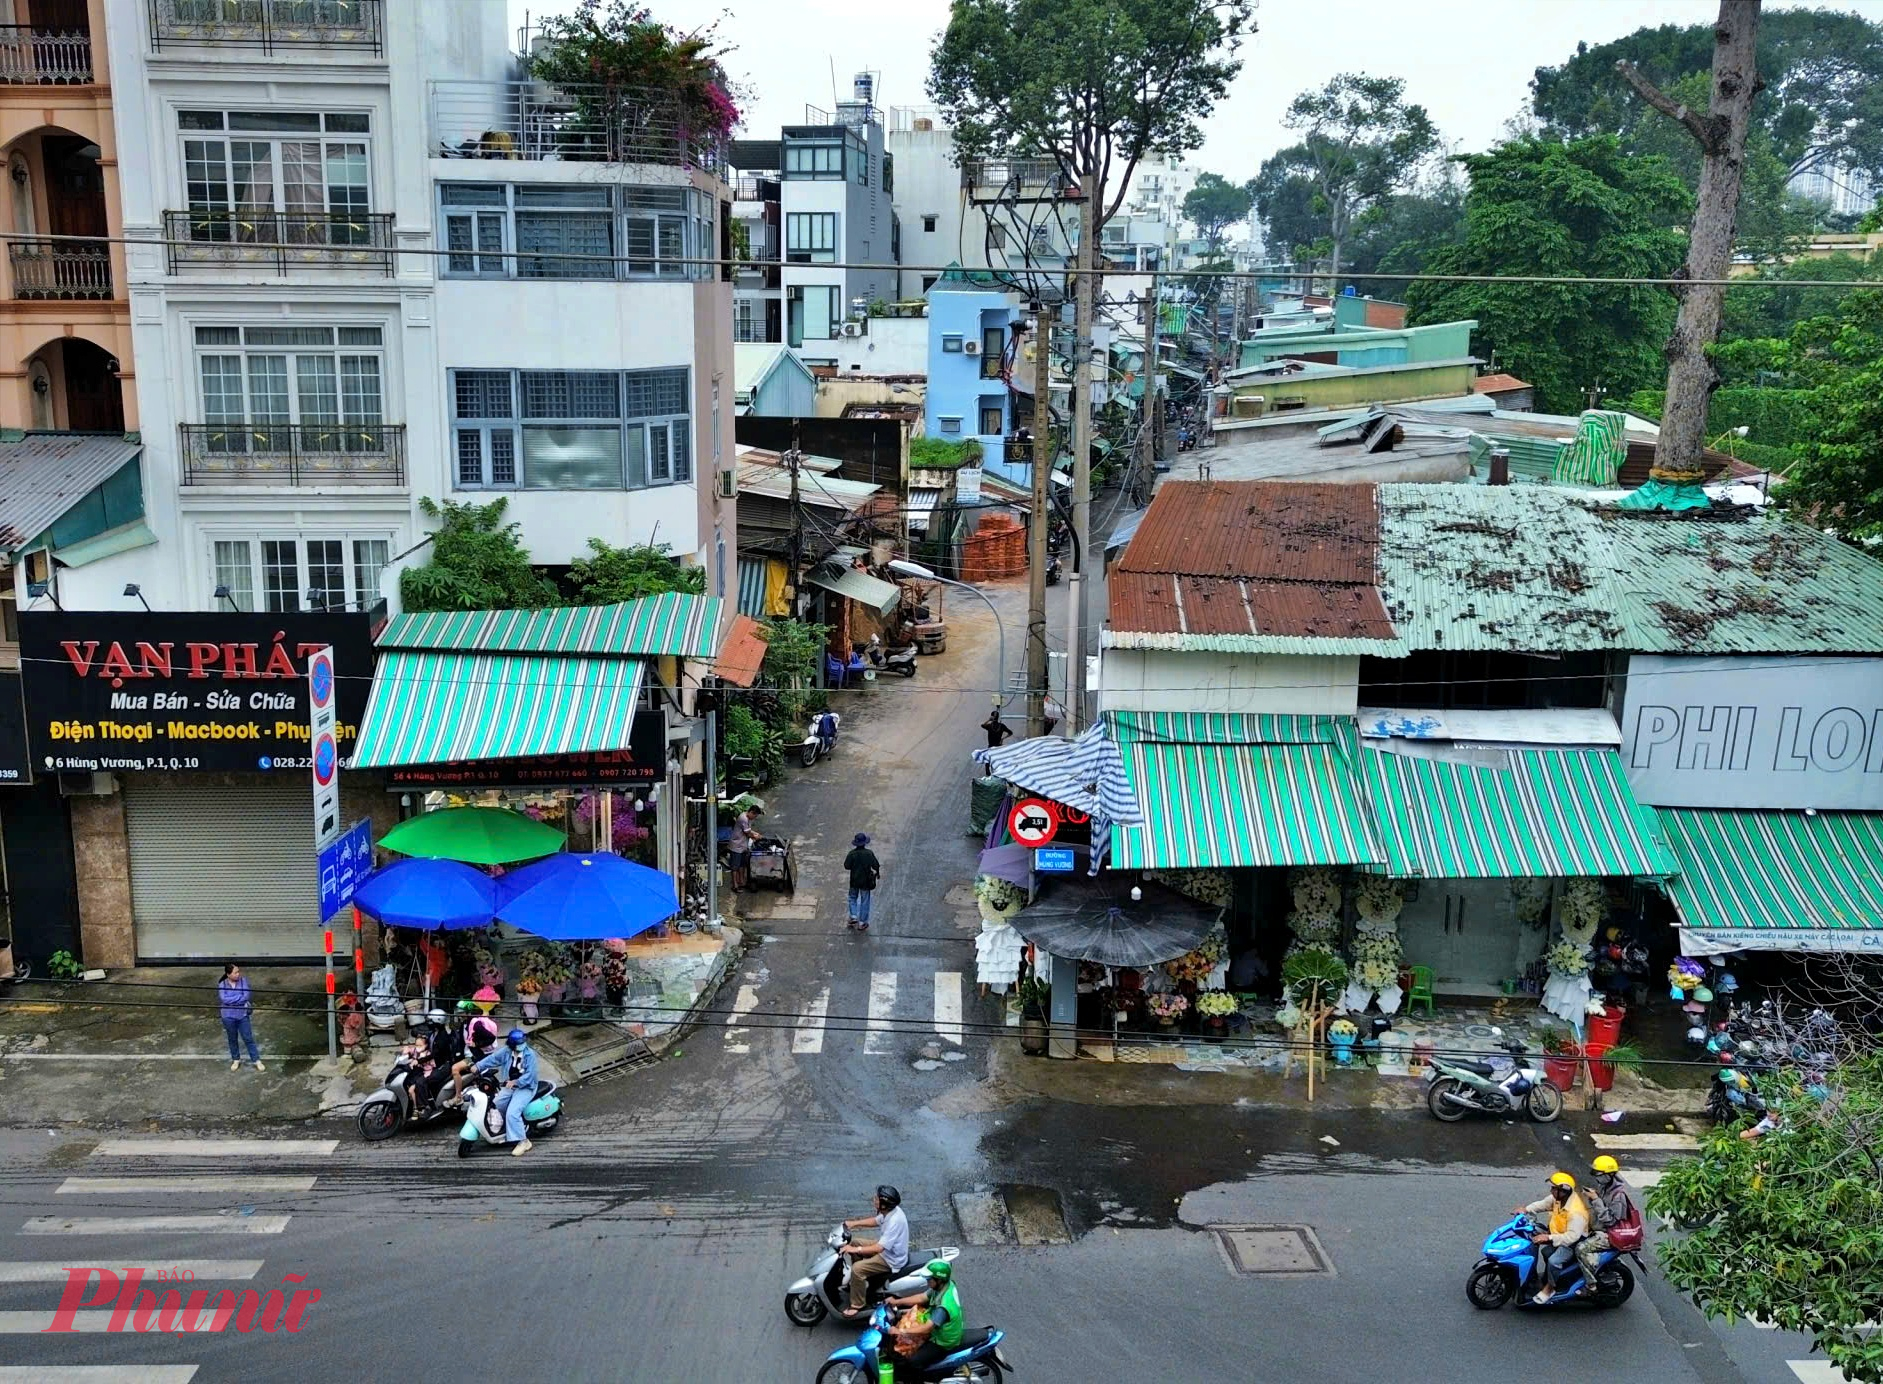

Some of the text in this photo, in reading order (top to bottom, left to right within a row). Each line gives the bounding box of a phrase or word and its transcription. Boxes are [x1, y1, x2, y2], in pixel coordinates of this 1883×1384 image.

[60, 640, 174, 688] VẠN
[111, 692, 147, 711] Mua
[152, 690, 188, 711] Bán
[206, 689, 240, 711] Sửa
[250, 691, 296, 711] Chữa
[50, 720, 95, 743] Điện
[99, 720, 153, 743] Thoại
[168, 721, 260, 740] Macbook
[275, 721, 311, 743] Phụ
[1631, 705, 1757, 770] PHI
[56, 757, 64, 768] 6
[66, 755, 98, 770] Hùng
[100, 757, 145, 770] Vương,
[599, 768, 620, 777] 0907
[639, 767, 655, 776] 798
